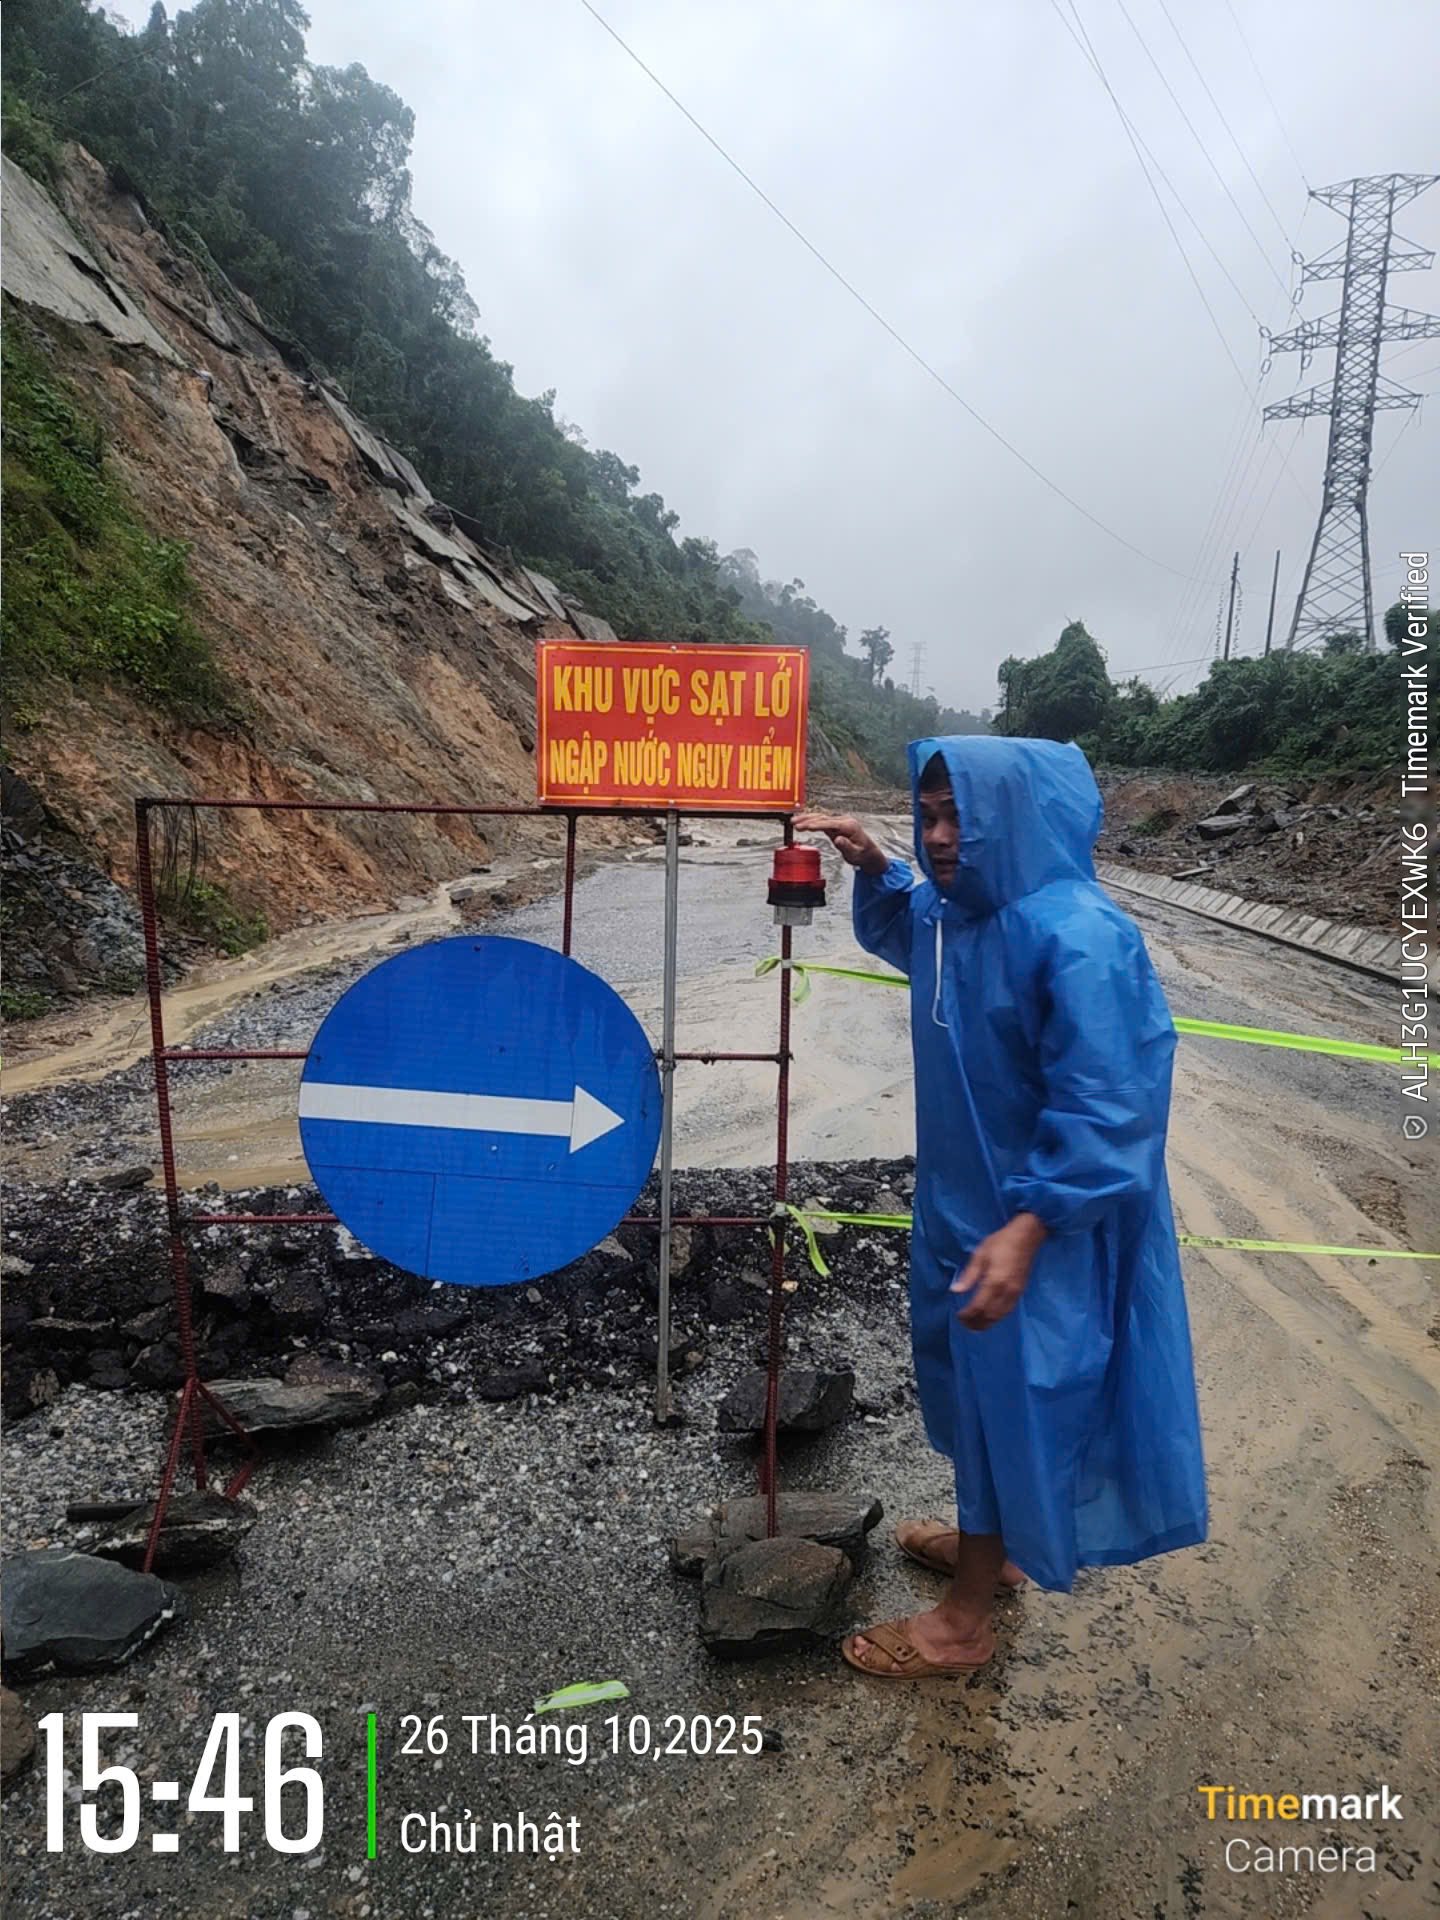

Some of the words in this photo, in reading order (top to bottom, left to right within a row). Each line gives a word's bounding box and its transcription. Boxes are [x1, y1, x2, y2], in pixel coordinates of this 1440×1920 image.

[553, 665, 613, 713] KHU
[623, 664, 680, 725] VỰC
[690, 670, 746, 726] SẠT
[754, 655, 792, 718] LỞ
[550, 731, 608, 794] NGẬP
[614, 729, 671, 787] NƯỚC
[677, 741, 733, 789] NGUY
[738, 726, 792, 790] HIỂM
